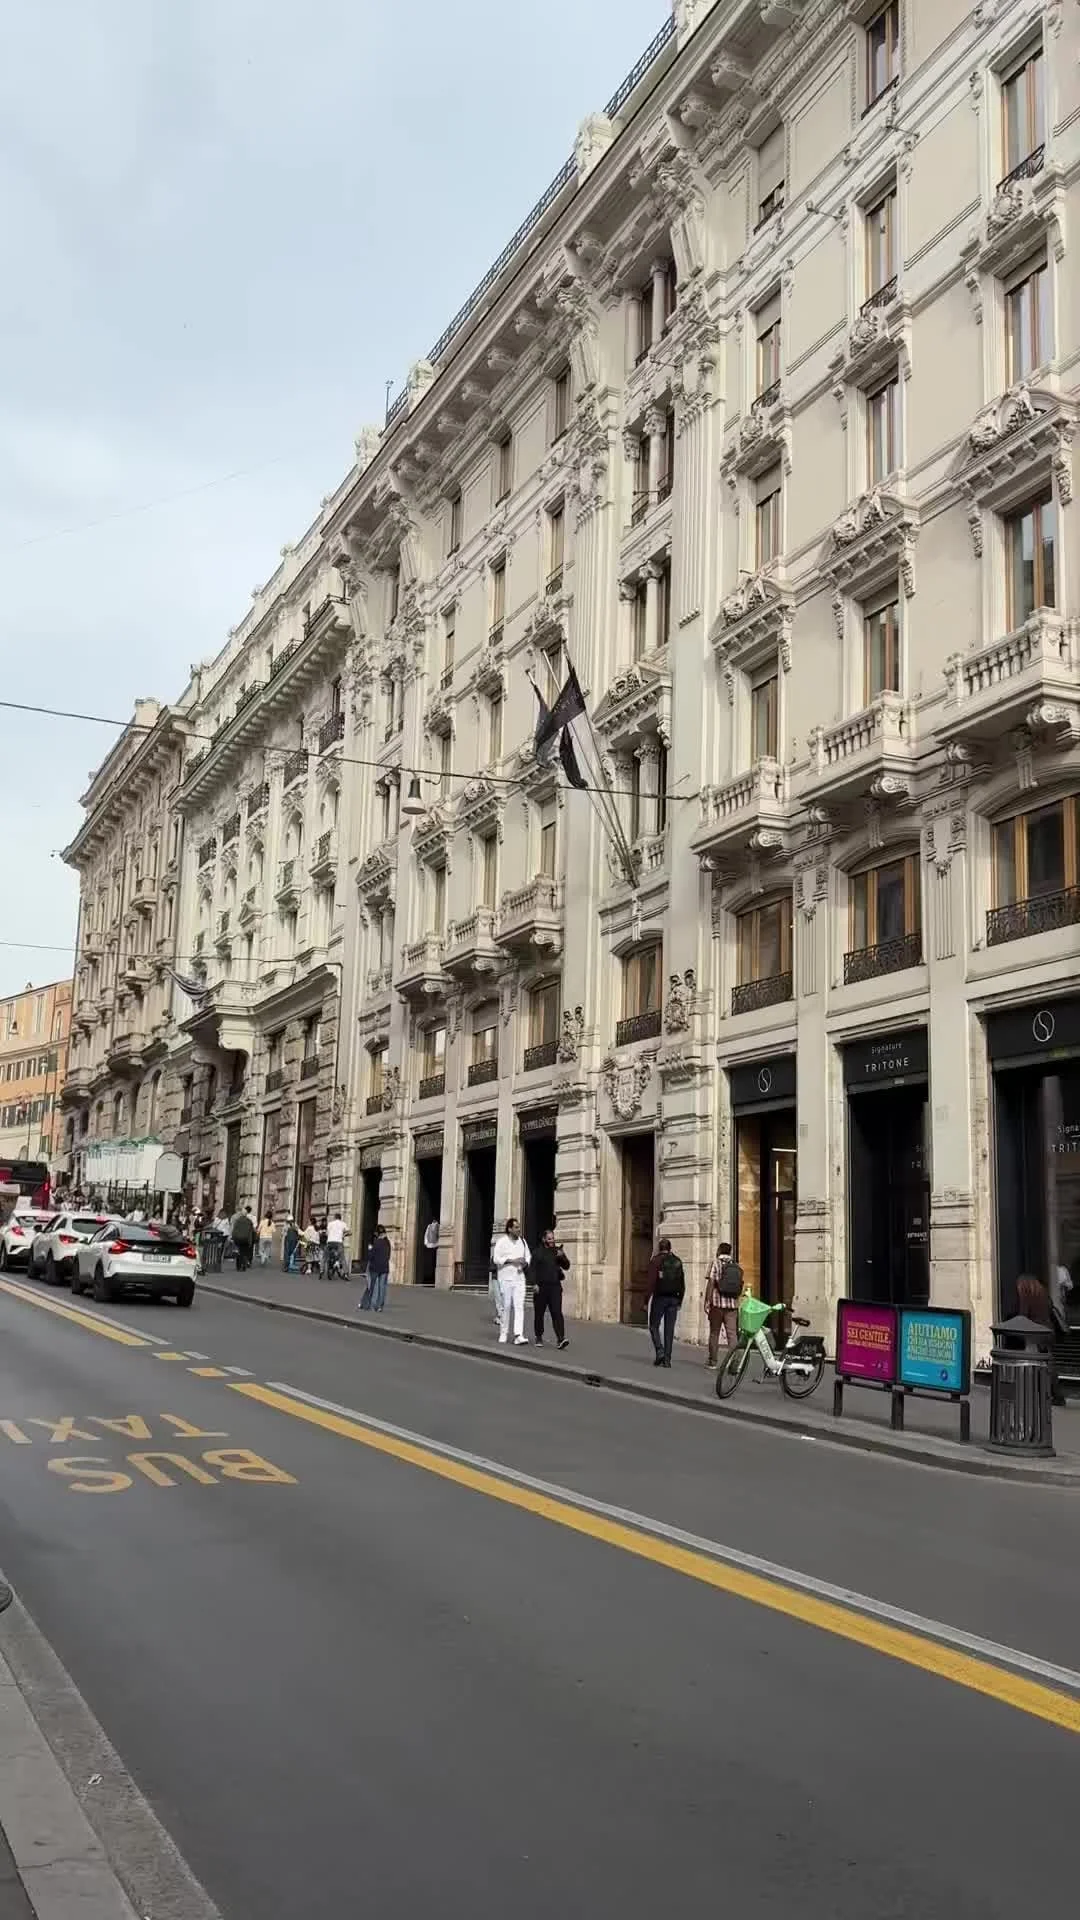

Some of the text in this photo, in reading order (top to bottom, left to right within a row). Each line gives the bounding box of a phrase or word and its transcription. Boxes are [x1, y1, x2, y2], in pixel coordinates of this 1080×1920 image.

[871, 1042, 902, 1054] Signature
[864, 1057, 910, 1073] TRITONE
[847, 1327, 858, 1338] SEI
[908, 1320, 957, 1341] AIUTIAMO
[0, 1414, 230, 1444] TAXI
[47, 1449, 299, 1493] BUS
